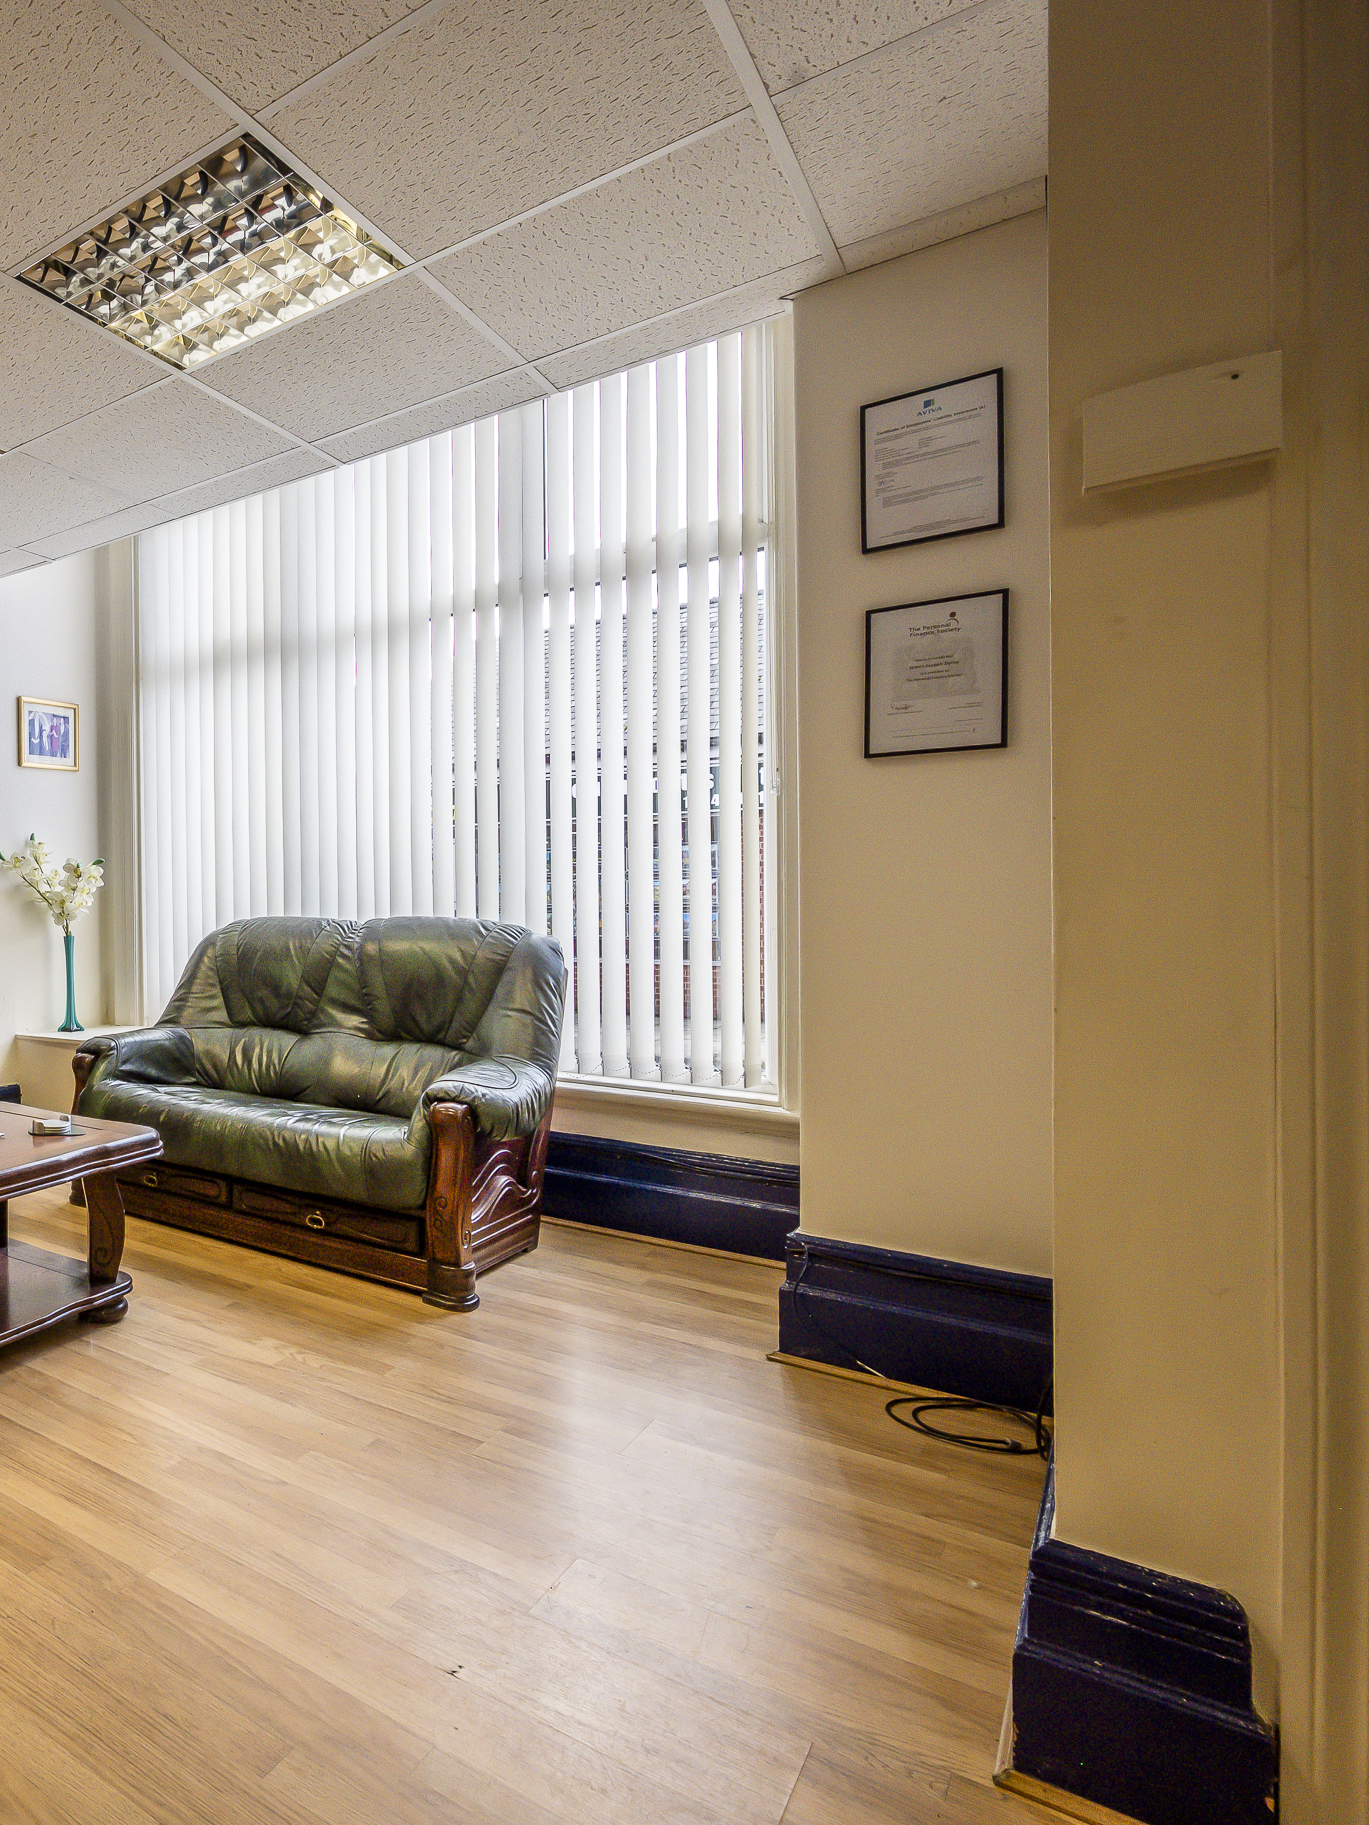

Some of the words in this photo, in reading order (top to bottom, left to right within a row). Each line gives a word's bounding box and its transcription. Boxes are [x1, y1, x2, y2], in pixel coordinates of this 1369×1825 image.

[916, 406, 943, 417] AVIVA
[922, 621, 952, 631] Personal
[936, 626, 962, 634] Society
